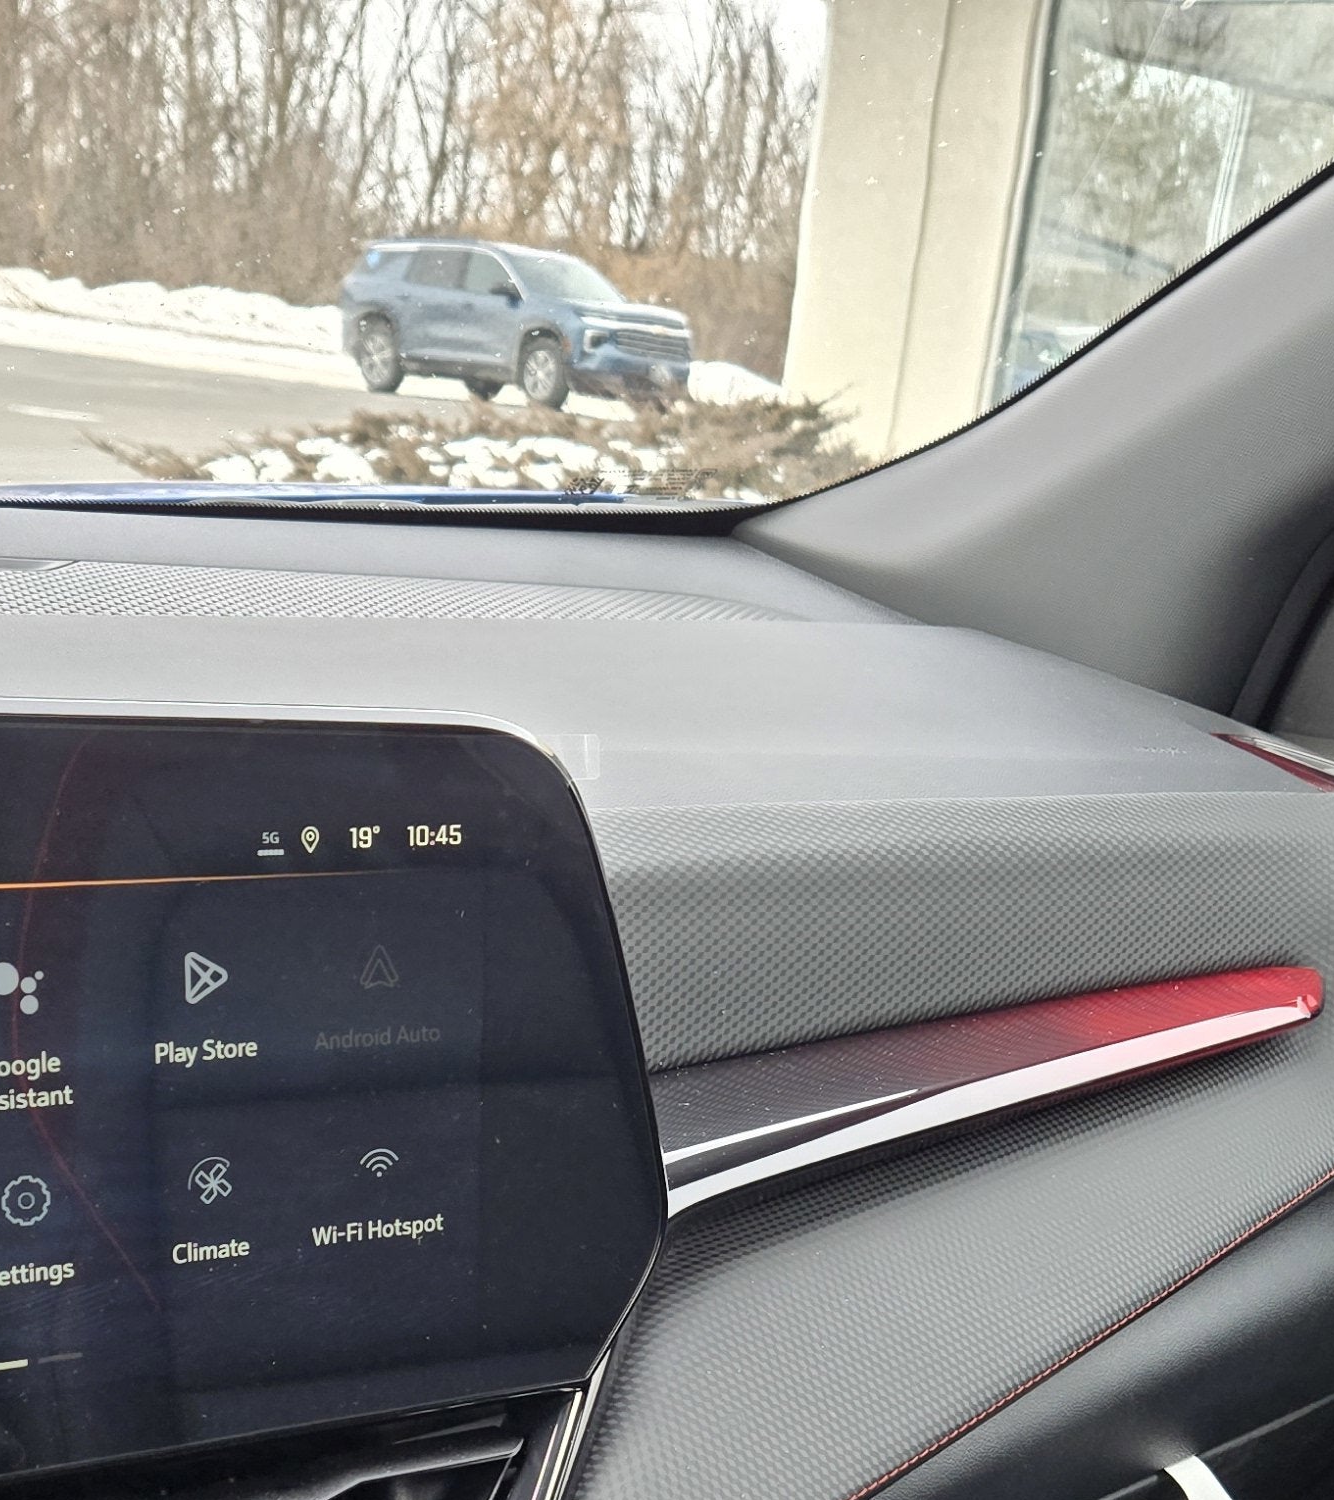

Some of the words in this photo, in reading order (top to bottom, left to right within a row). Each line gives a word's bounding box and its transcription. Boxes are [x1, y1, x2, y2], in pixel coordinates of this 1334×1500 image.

[261, 831, 280, 845] 5G
[348, 825, 381, 849] 19°
[407, 824, 462, 847] 10:45
[314, 1028, 392, 1052] Android
[396, 1024, 441, 1046] Auto
[154, 1042, 198, 1069] Play
[202, 1037, 258, 1062] Store
[312, 1222, 363, 1246] Wi-Fi
[367, 1213, 444, 1243] Hotspot
[172, 1238, 250, 1264] Climate
